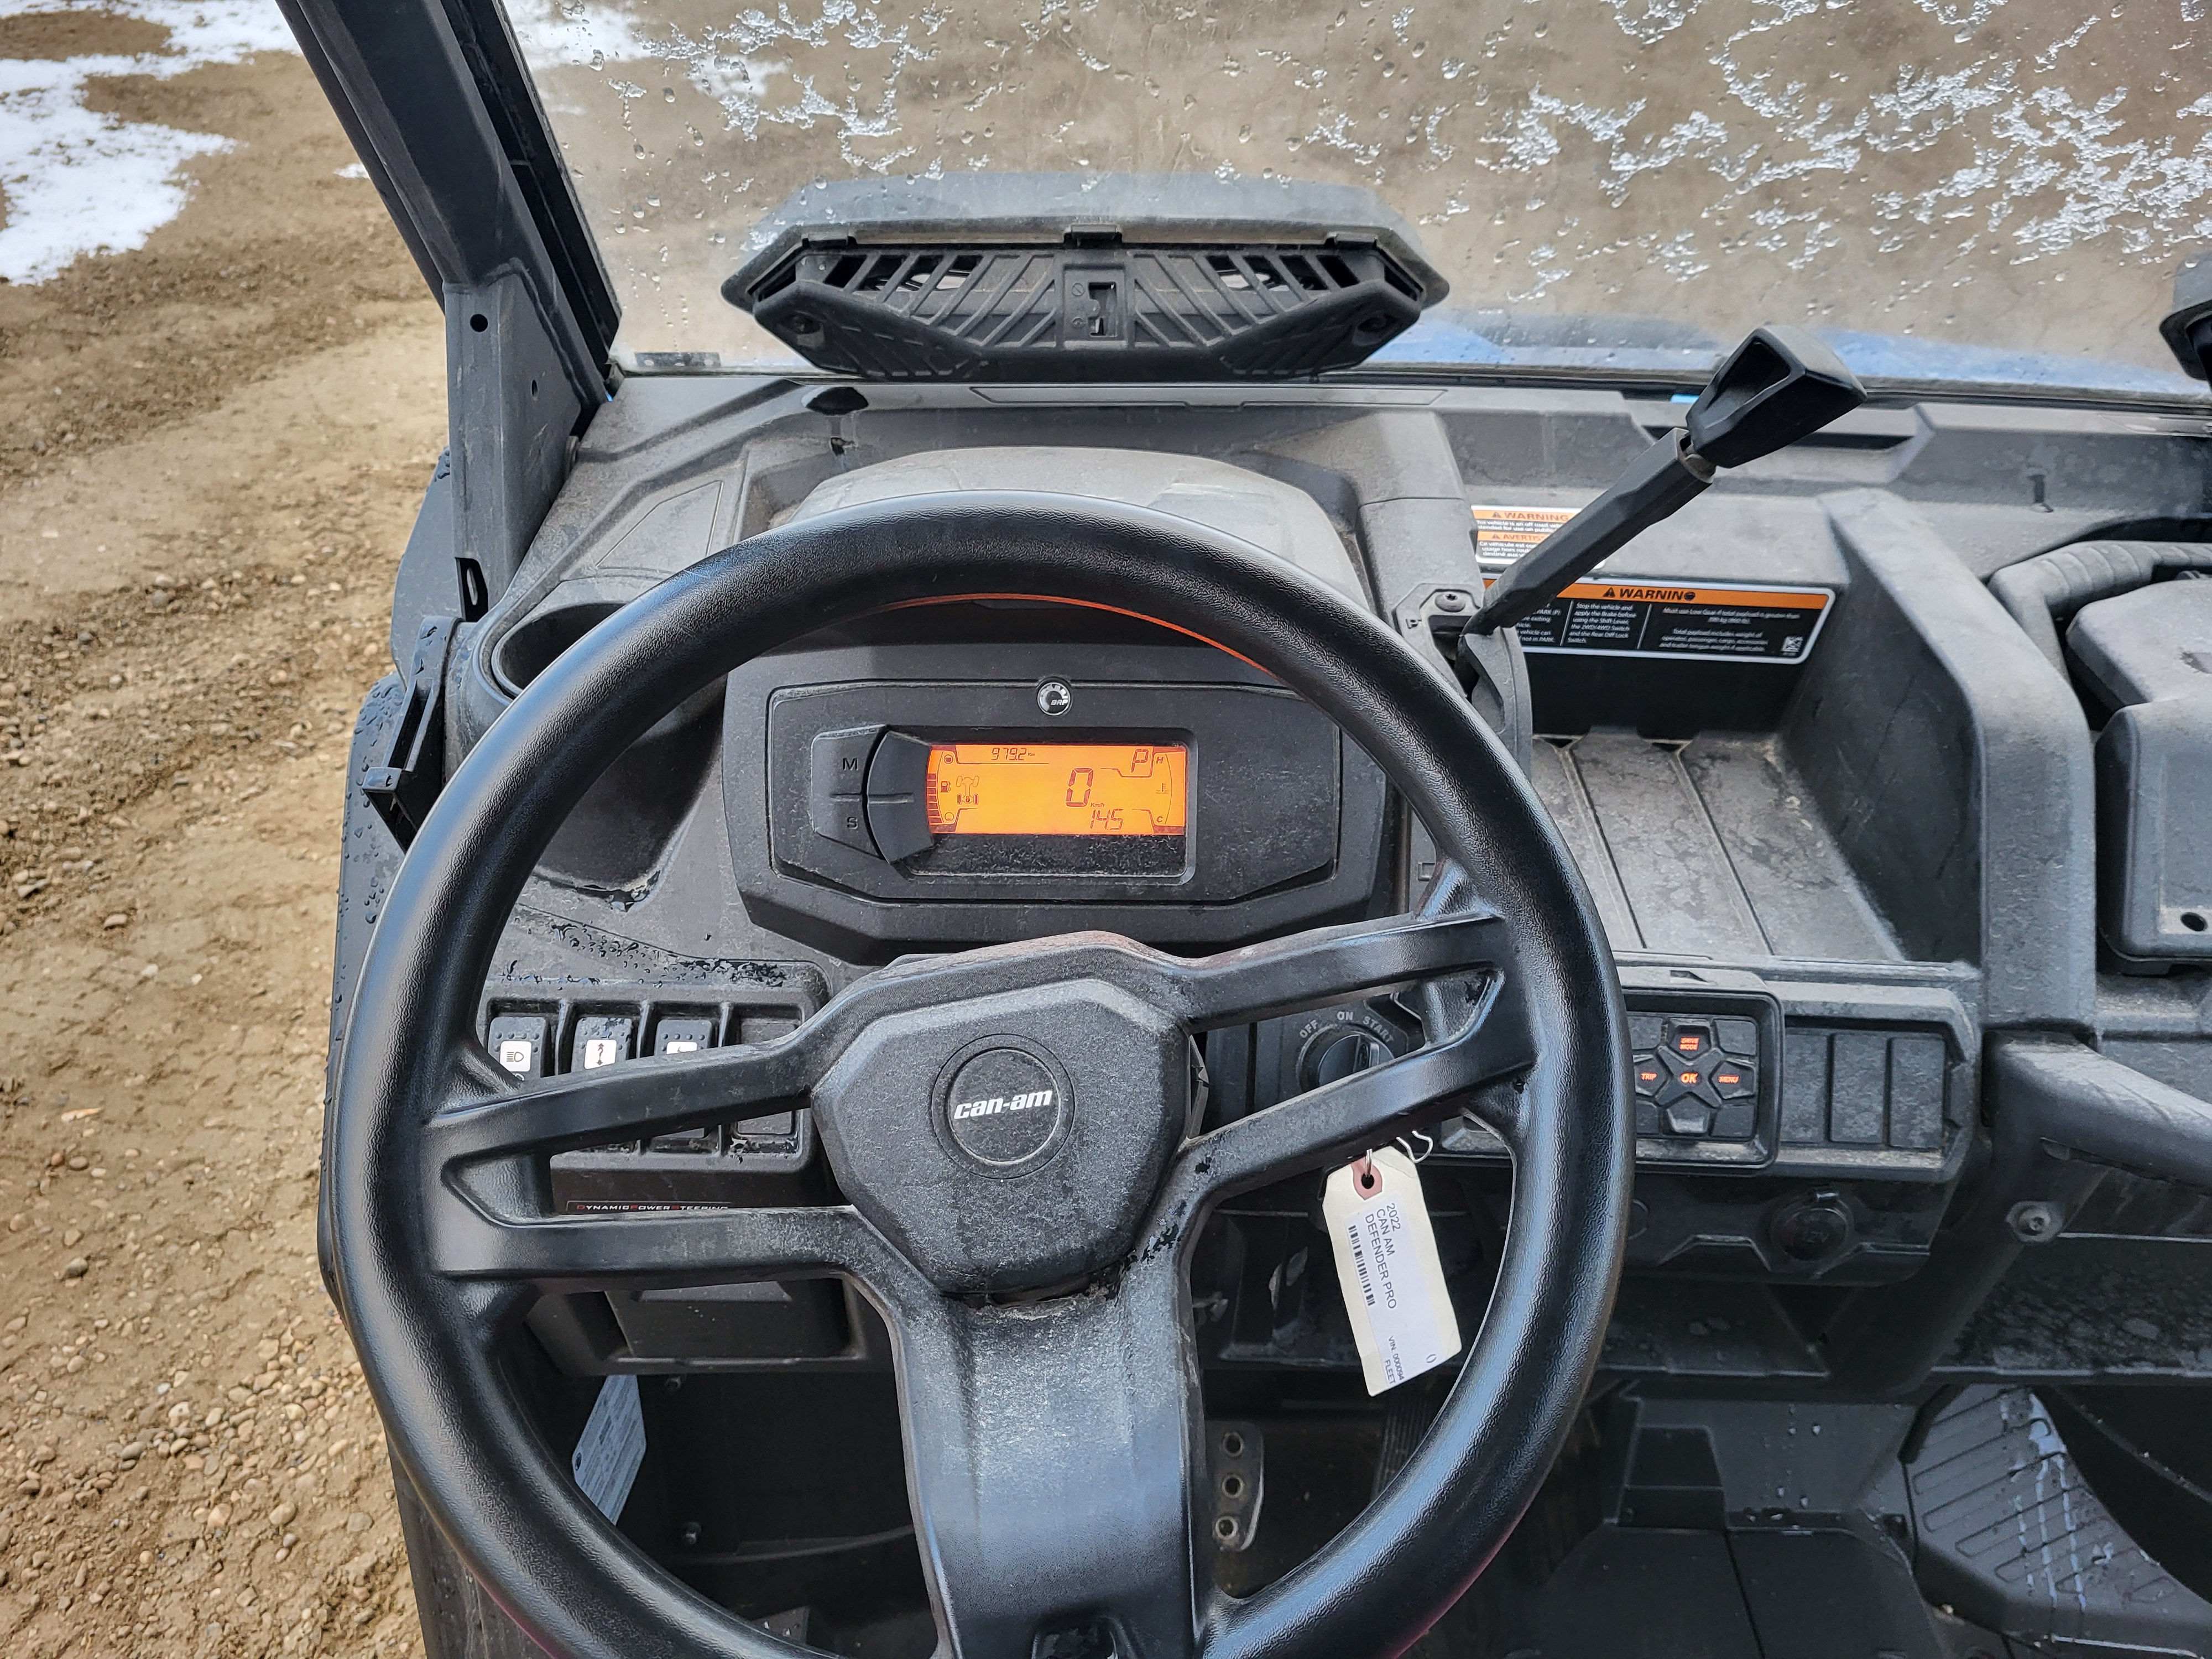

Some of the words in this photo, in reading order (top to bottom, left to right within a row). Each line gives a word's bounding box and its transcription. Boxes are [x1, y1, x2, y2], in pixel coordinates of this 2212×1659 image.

[1504, 512, 1568, 521] WARNING
[1620, 588, 1695, 601] WARNIN
[842, 758, 858, 771] M
[1131, 748, 1149, 774] P
[1156, 755, 1164, 765] H
[1065, 767, 1094, 807] 0
[847, 816, 858, 830] S
[1091, 808, 1124, 831] 145
[1156, 815, 1164, 823] C
[1300, 1020, 1318, 1038] OFF
[1337, 1011, 1354, 1021] ON
[1361, 1015, 1394, 1042] START
[1640, 1072, 1658, 1081] TRIP
[1681, 1072, 1699, 1084] OK
[1718, 1074, 1740, 1084] MENU
[954, 1090, 1052, 1119] can-am
[1376, 1208, 1391, 1235] CAN
[1386, 1203, 1401, 1232] 2022
[1383, 1237, 1395, 1256] AM
[1365, 1213, 1389, 1281] DEFENDER
[1382, 1281, 1397, 1310] PRO
[1384, 1359, 1396, 1384] FLEET
